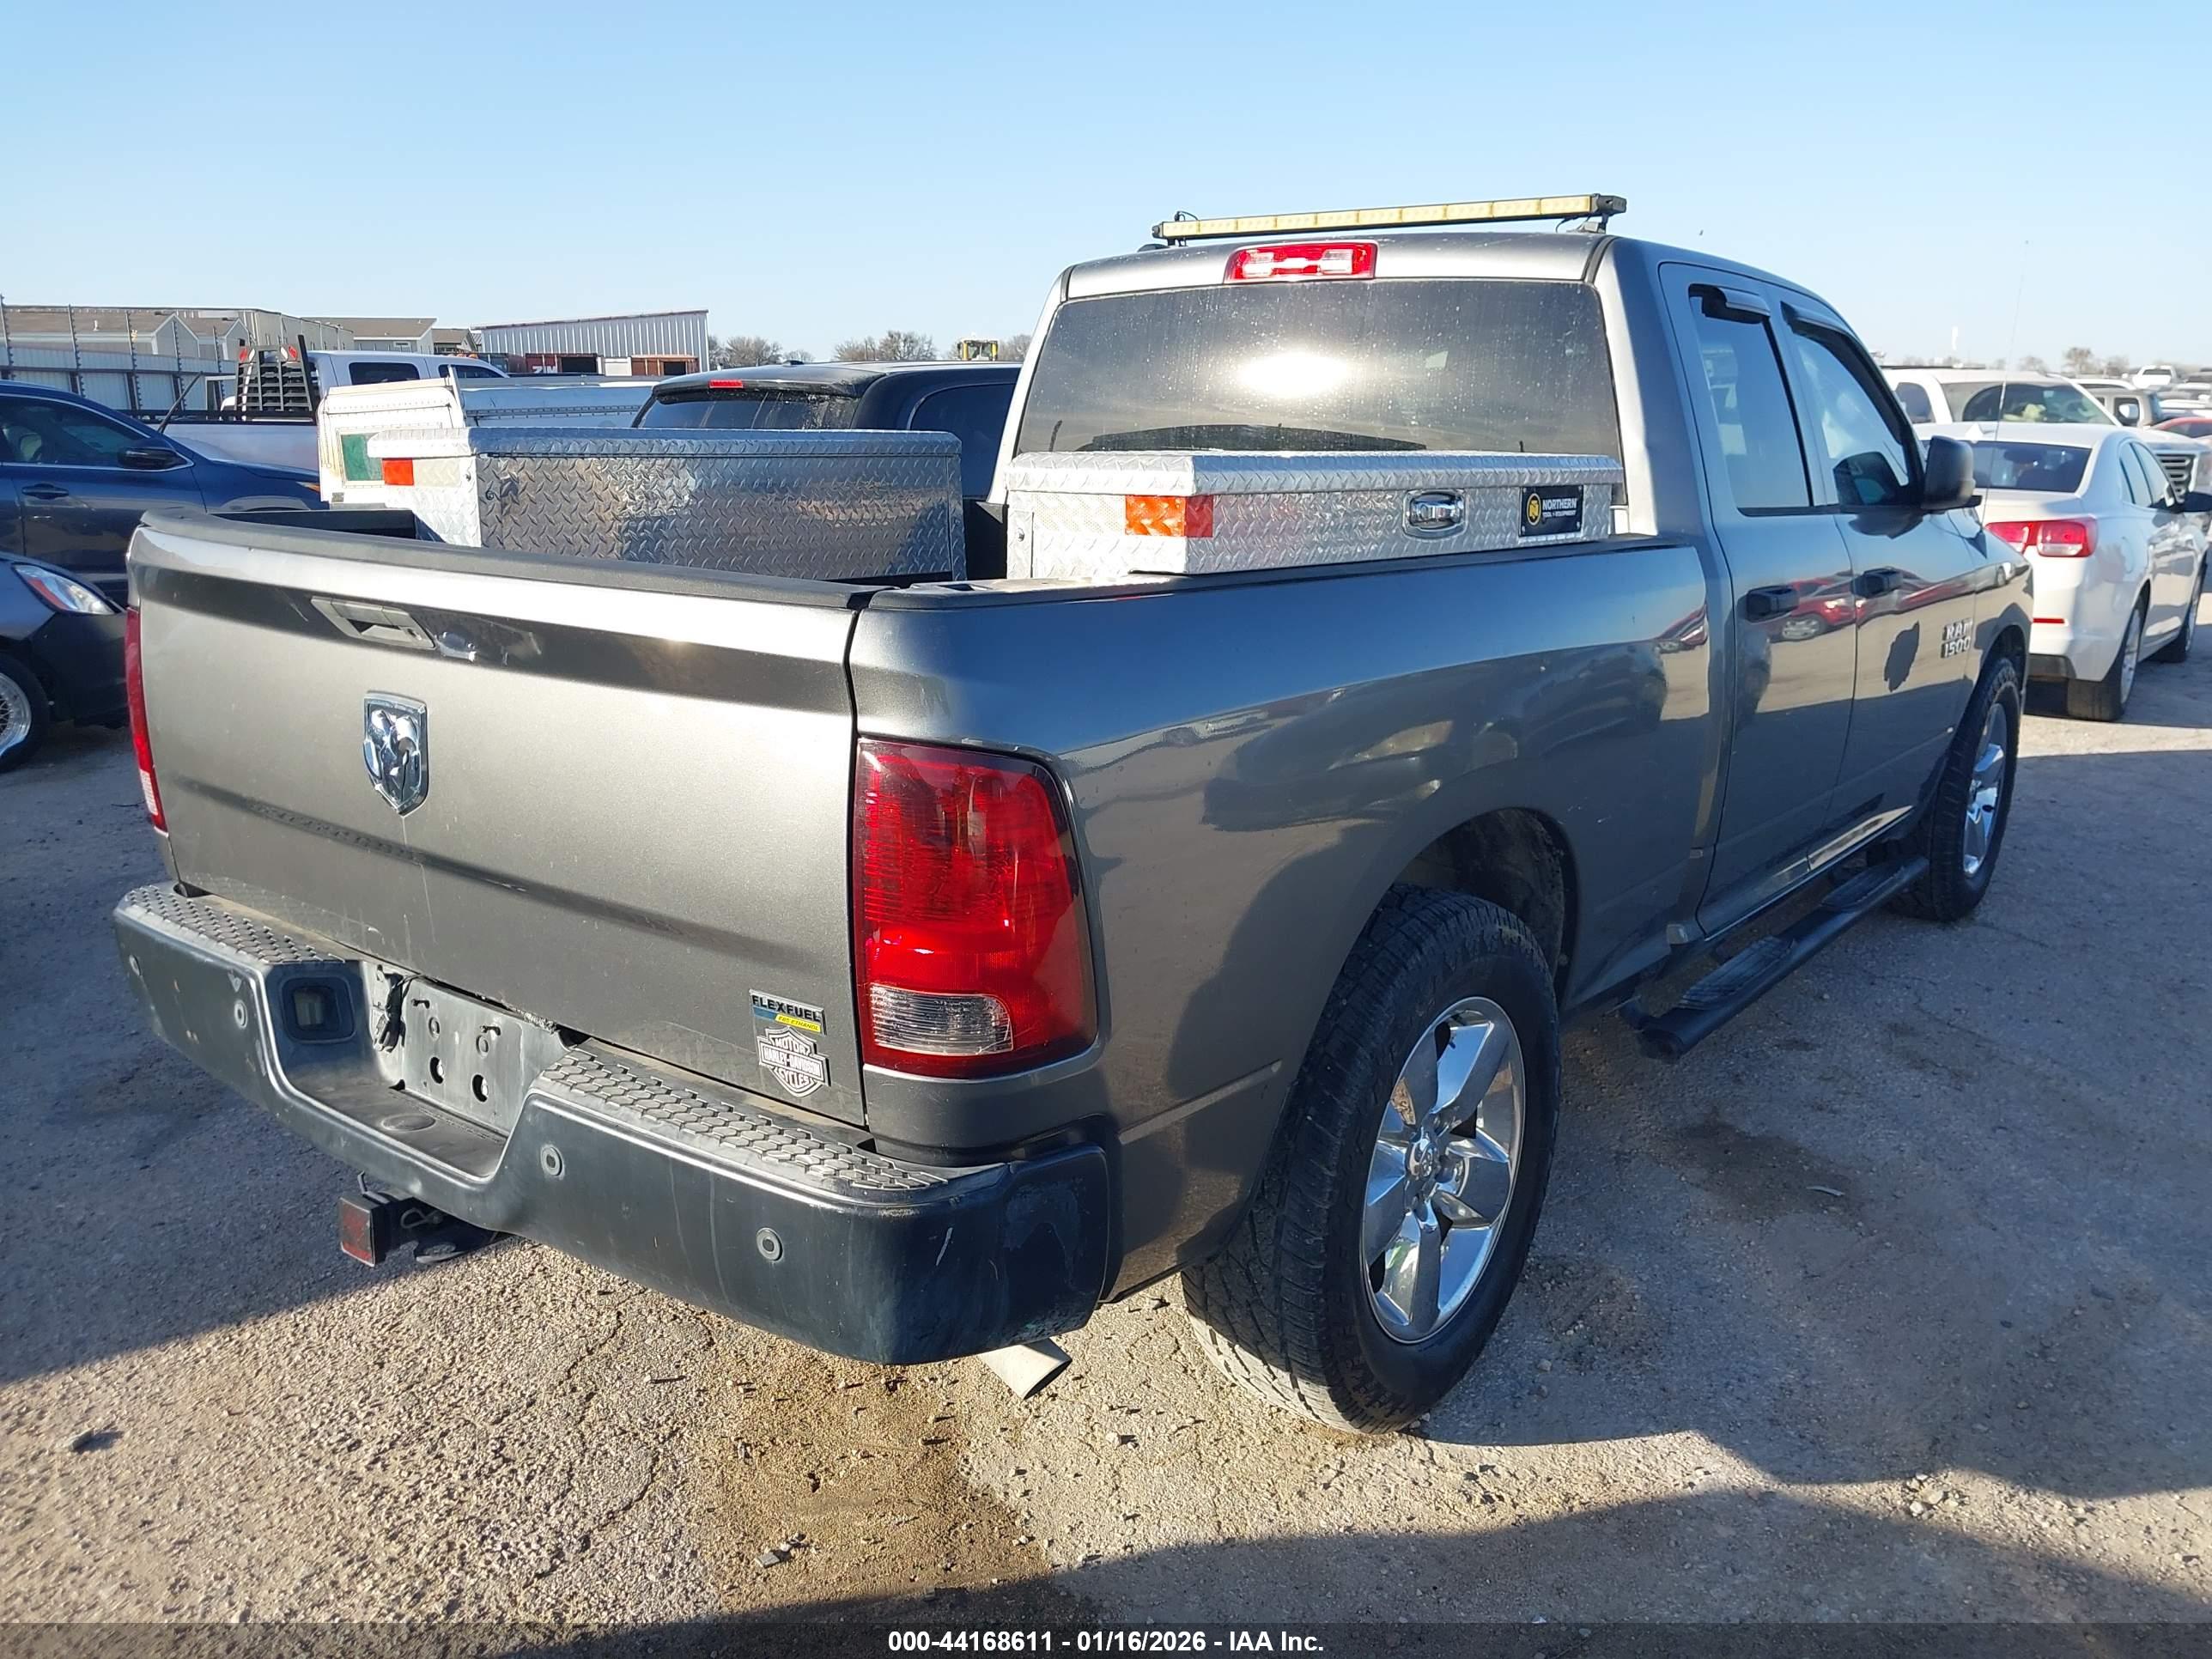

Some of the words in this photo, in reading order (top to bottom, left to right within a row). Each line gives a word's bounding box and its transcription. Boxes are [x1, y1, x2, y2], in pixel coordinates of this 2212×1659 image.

[1542, 498, 1577, 510] NORTHERN
[1942, 635, 1971, 659] 1500
[791, 1018, 819, 1030] ETHANOL
[773, 1036, 809, 1055] MOTOR
[763, 1046, 820, 1077] HARLEY-DAVIDSON
[777, 1067, 810, 1088] CYCLES
